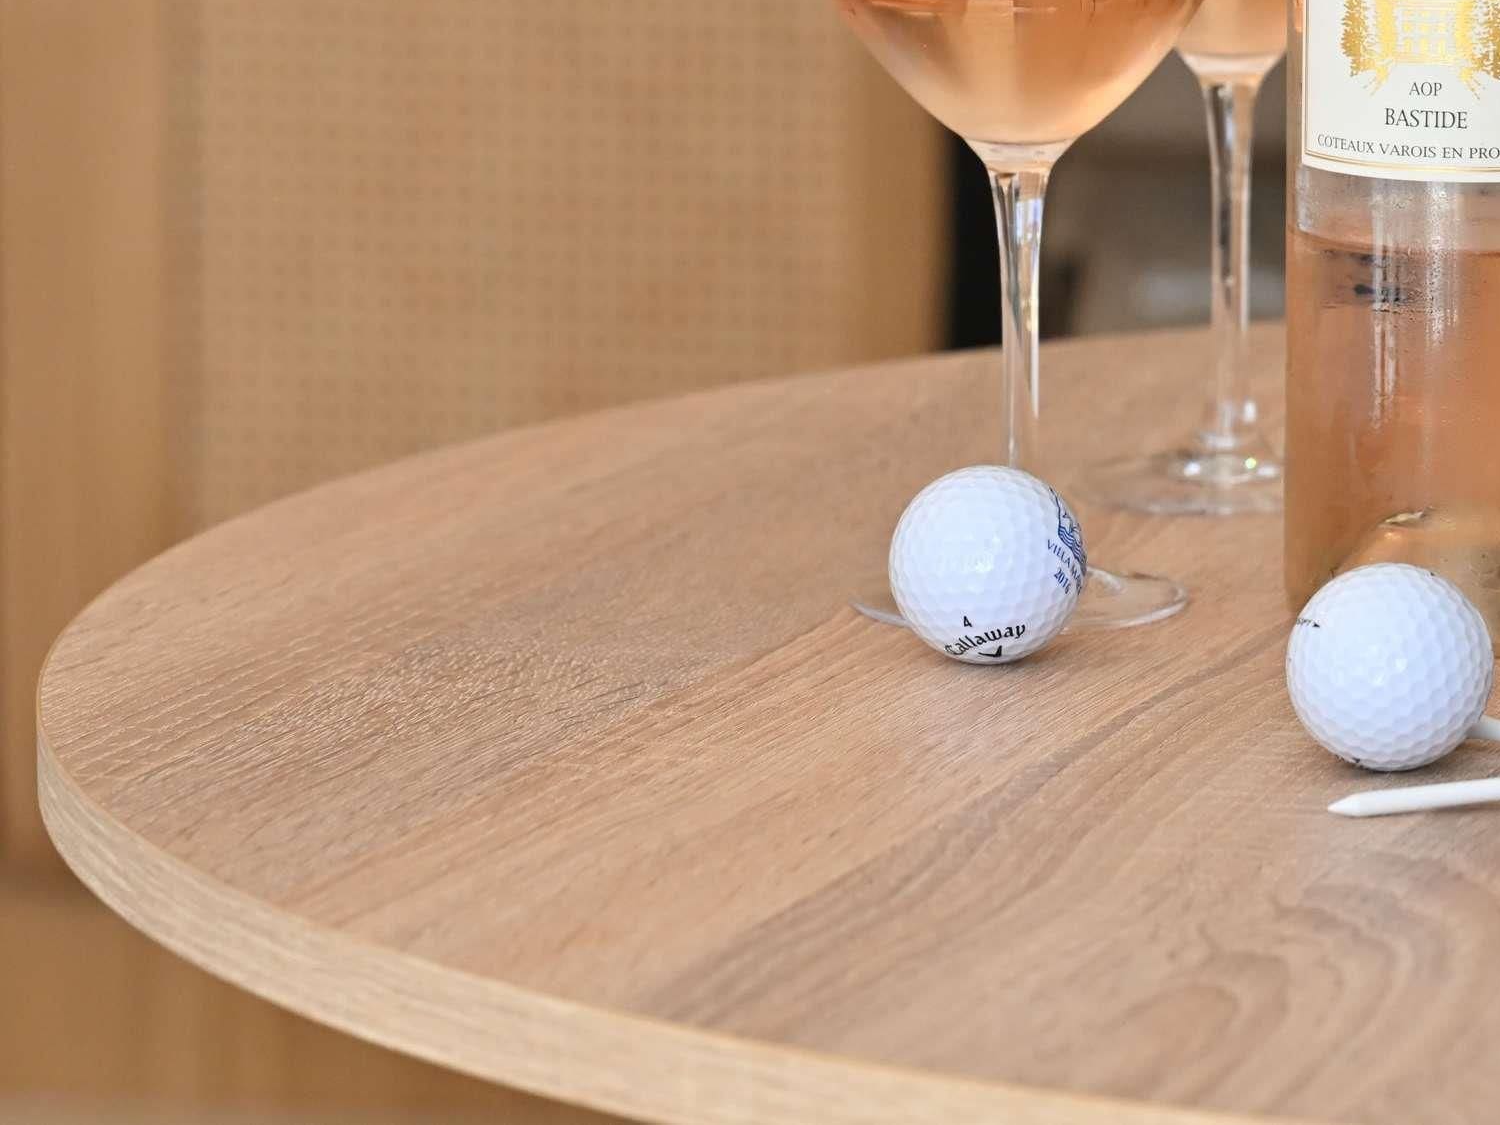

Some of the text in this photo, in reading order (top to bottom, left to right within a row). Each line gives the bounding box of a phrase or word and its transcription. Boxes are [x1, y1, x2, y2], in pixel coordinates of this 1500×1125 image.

[1408, 81, 1443, 97] AOP
[1384, 107, 1468, 130] BASTIDE
[1317, 134, 1375, 154] COTEAUX
[1379, 143, 1437, 159] VAROIS
[1443, 147, 1463, 159] EN
[963, 615, 972, 627] 4
[945, 624, 1026, 655] Callaway
